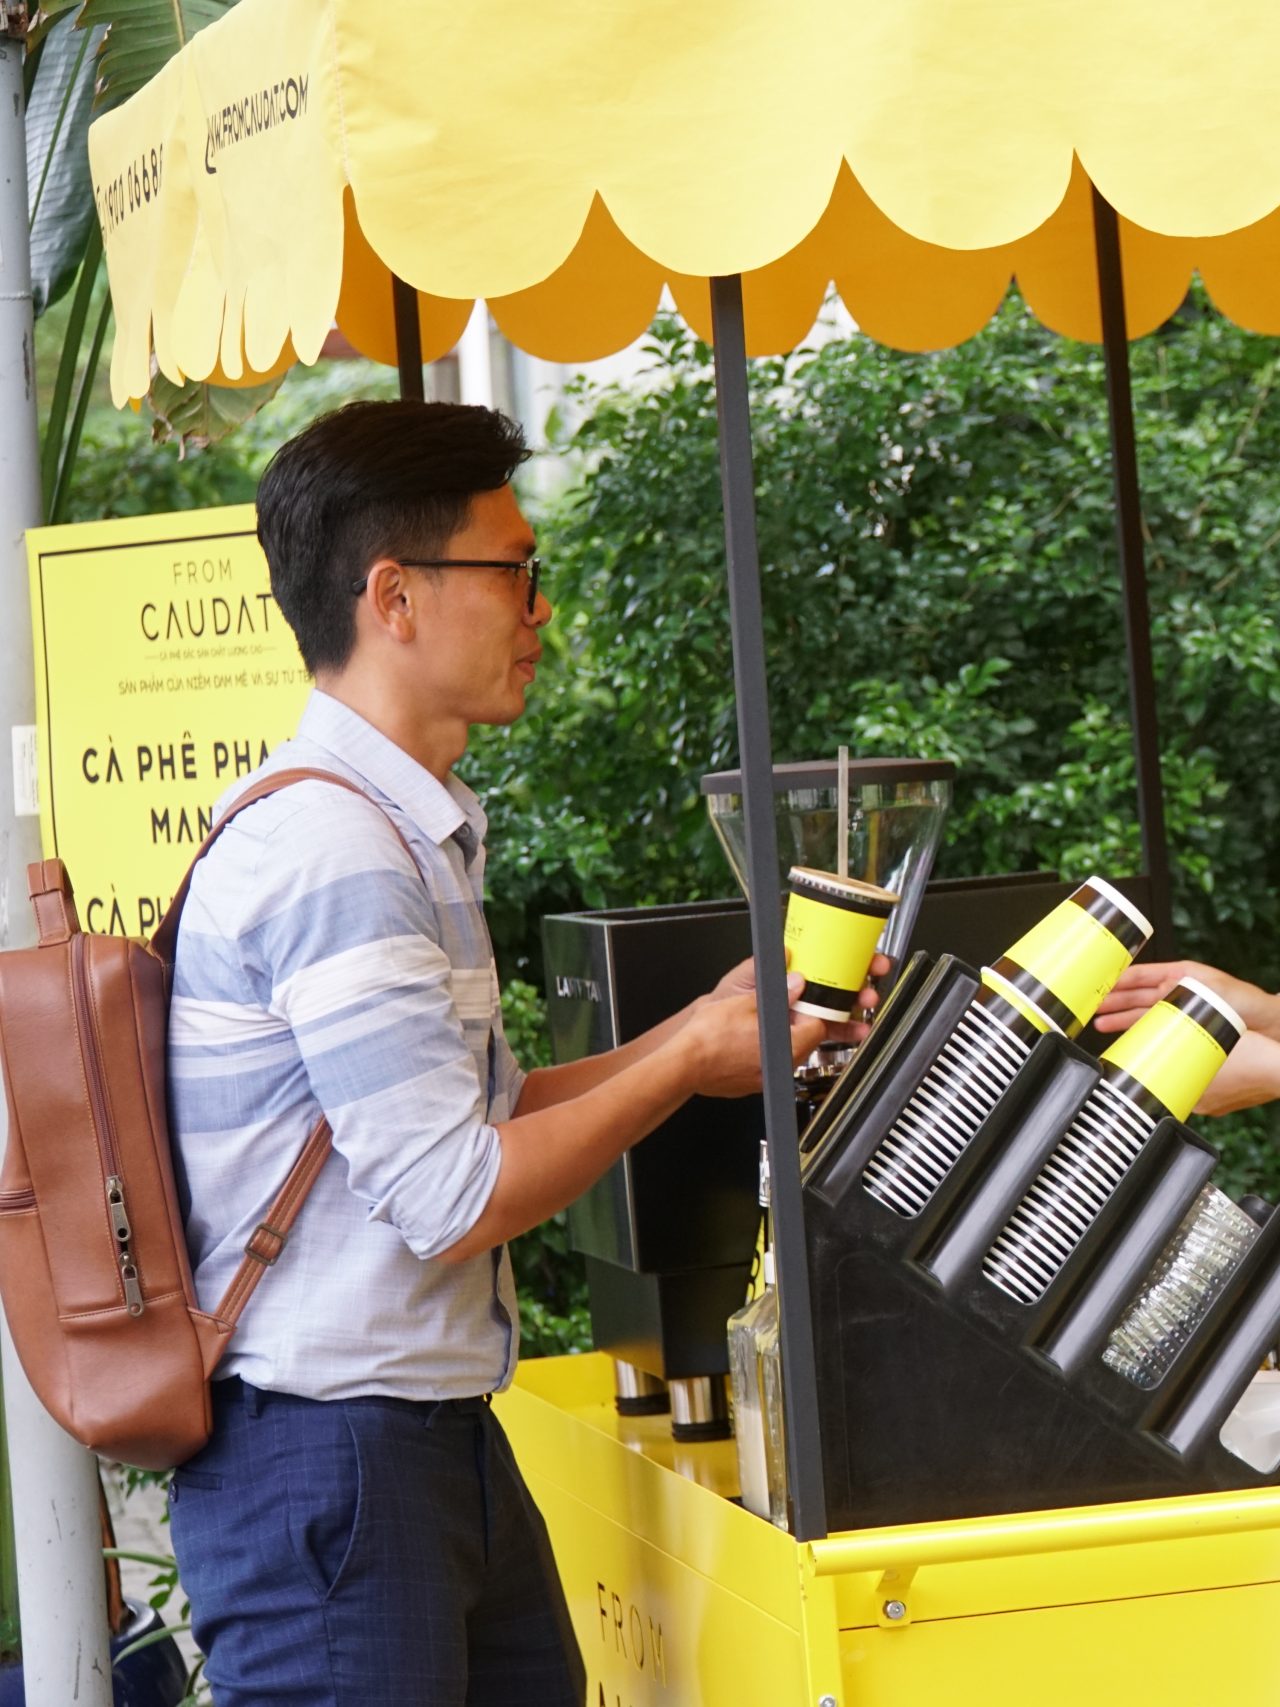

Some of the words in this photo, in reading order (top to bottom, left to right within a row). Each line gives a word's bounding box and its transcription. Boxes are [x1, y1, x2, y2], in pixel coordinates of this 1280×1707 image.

[173, 558, 232, 584] FROM
[141, 594, 272, 641] CAUDAT
[82, 735, 123, 783] CÀ
[137, 731, 197, 781] PHÊ
[87, 883, 126, 937] CÀ
[597, 1580, 666, 1689] FROM
